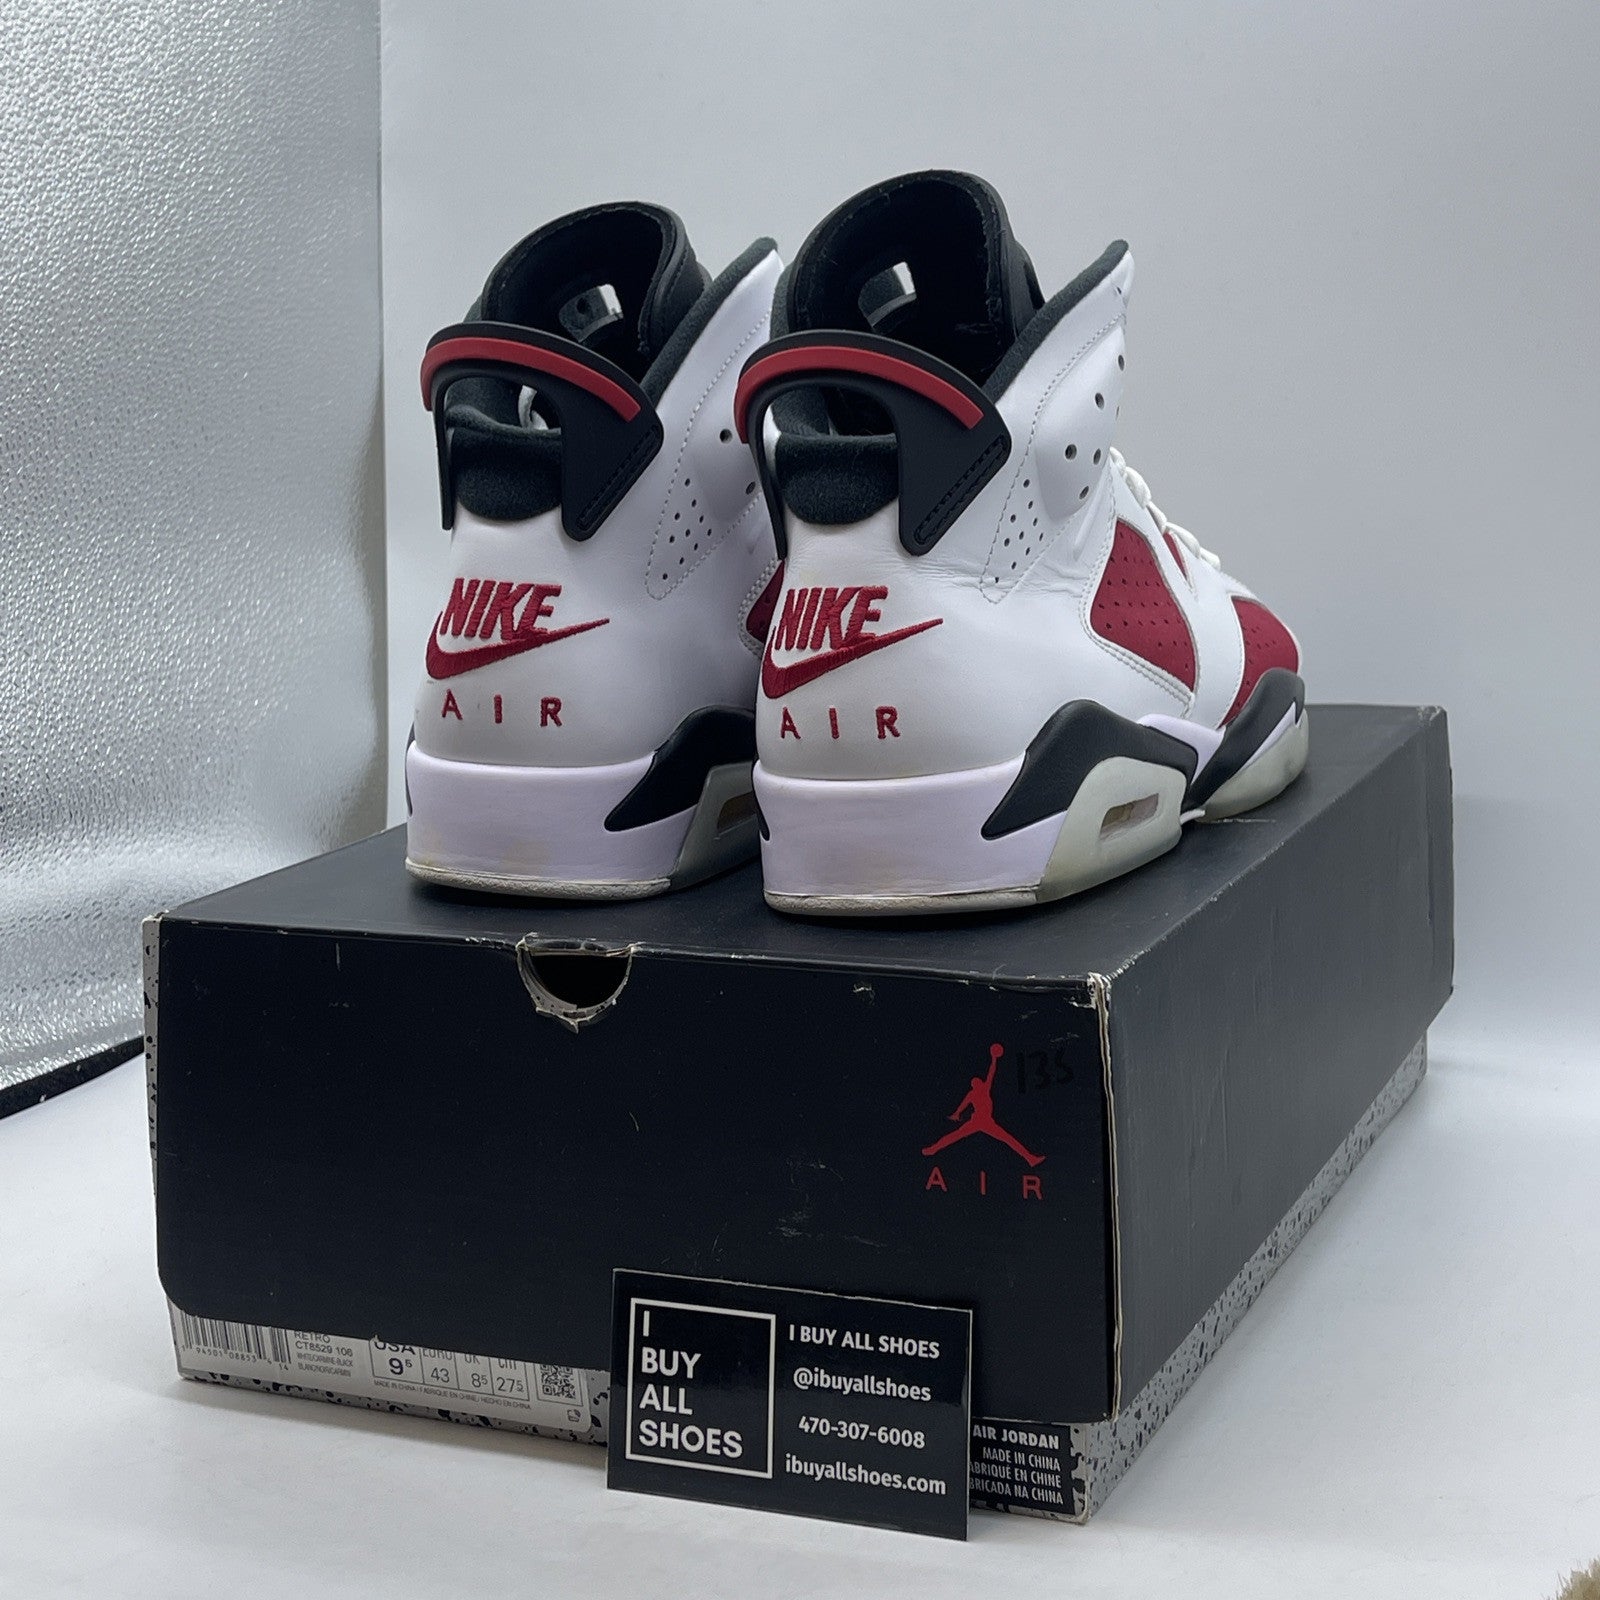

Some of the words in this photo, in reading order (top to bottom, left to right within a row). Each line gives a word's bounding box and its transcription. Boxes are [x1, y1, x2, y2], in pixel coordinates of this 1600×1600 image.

[440, 577, 562, 642] NIKE
[775, 585, 889, 651] NIKE
[441, 689, 562, 727] AIR
[779, 705, 900, 740] AIR
[926, 1166, 1043, 1200] AIR
[294, 1331, 331, 1344] RETRO
[642, 1310, 650, 1337] I
[295, 1340, 333, 1354] CT8529
[789, 1324, 795, 1341] I
[800, 1326, 837, 1346] BUY
[841, 1331, 874, 1352] ALL
[878, 1335, 940, 1359] SHOES
[430, 1367, 450, 1383] 43
[641, 1347, 702, 1379] BUY
[639, 1383, 693, 1415] ALL
[793, 1367, 931, 1402] @ibuyallshoes
[639, 1419, 743, 1458] SHOES
[798, 1416, 925, 1449] 470-307-6008
[972, 1425, 997, 1440] AIR
[1001, 1428, 1060, 1450] JORDAN
[785, 1453, 946, 1495] ibuyallshoes.com
[982, 1447, 1012, 1464] MADE
[1014, 1451, 1026, 1466] IN
[1028, 1453, 1061, 1472] CHINA
[969, 1477, 1012, 1497] BRICADA
[1014, 1484, 1029, 1499] NA
[1031, 1487, 1064, 1505] CHINA
[1014, 1467, 1028, 1483] EN
[1030, 1470, 1062, 1489] CHINE
